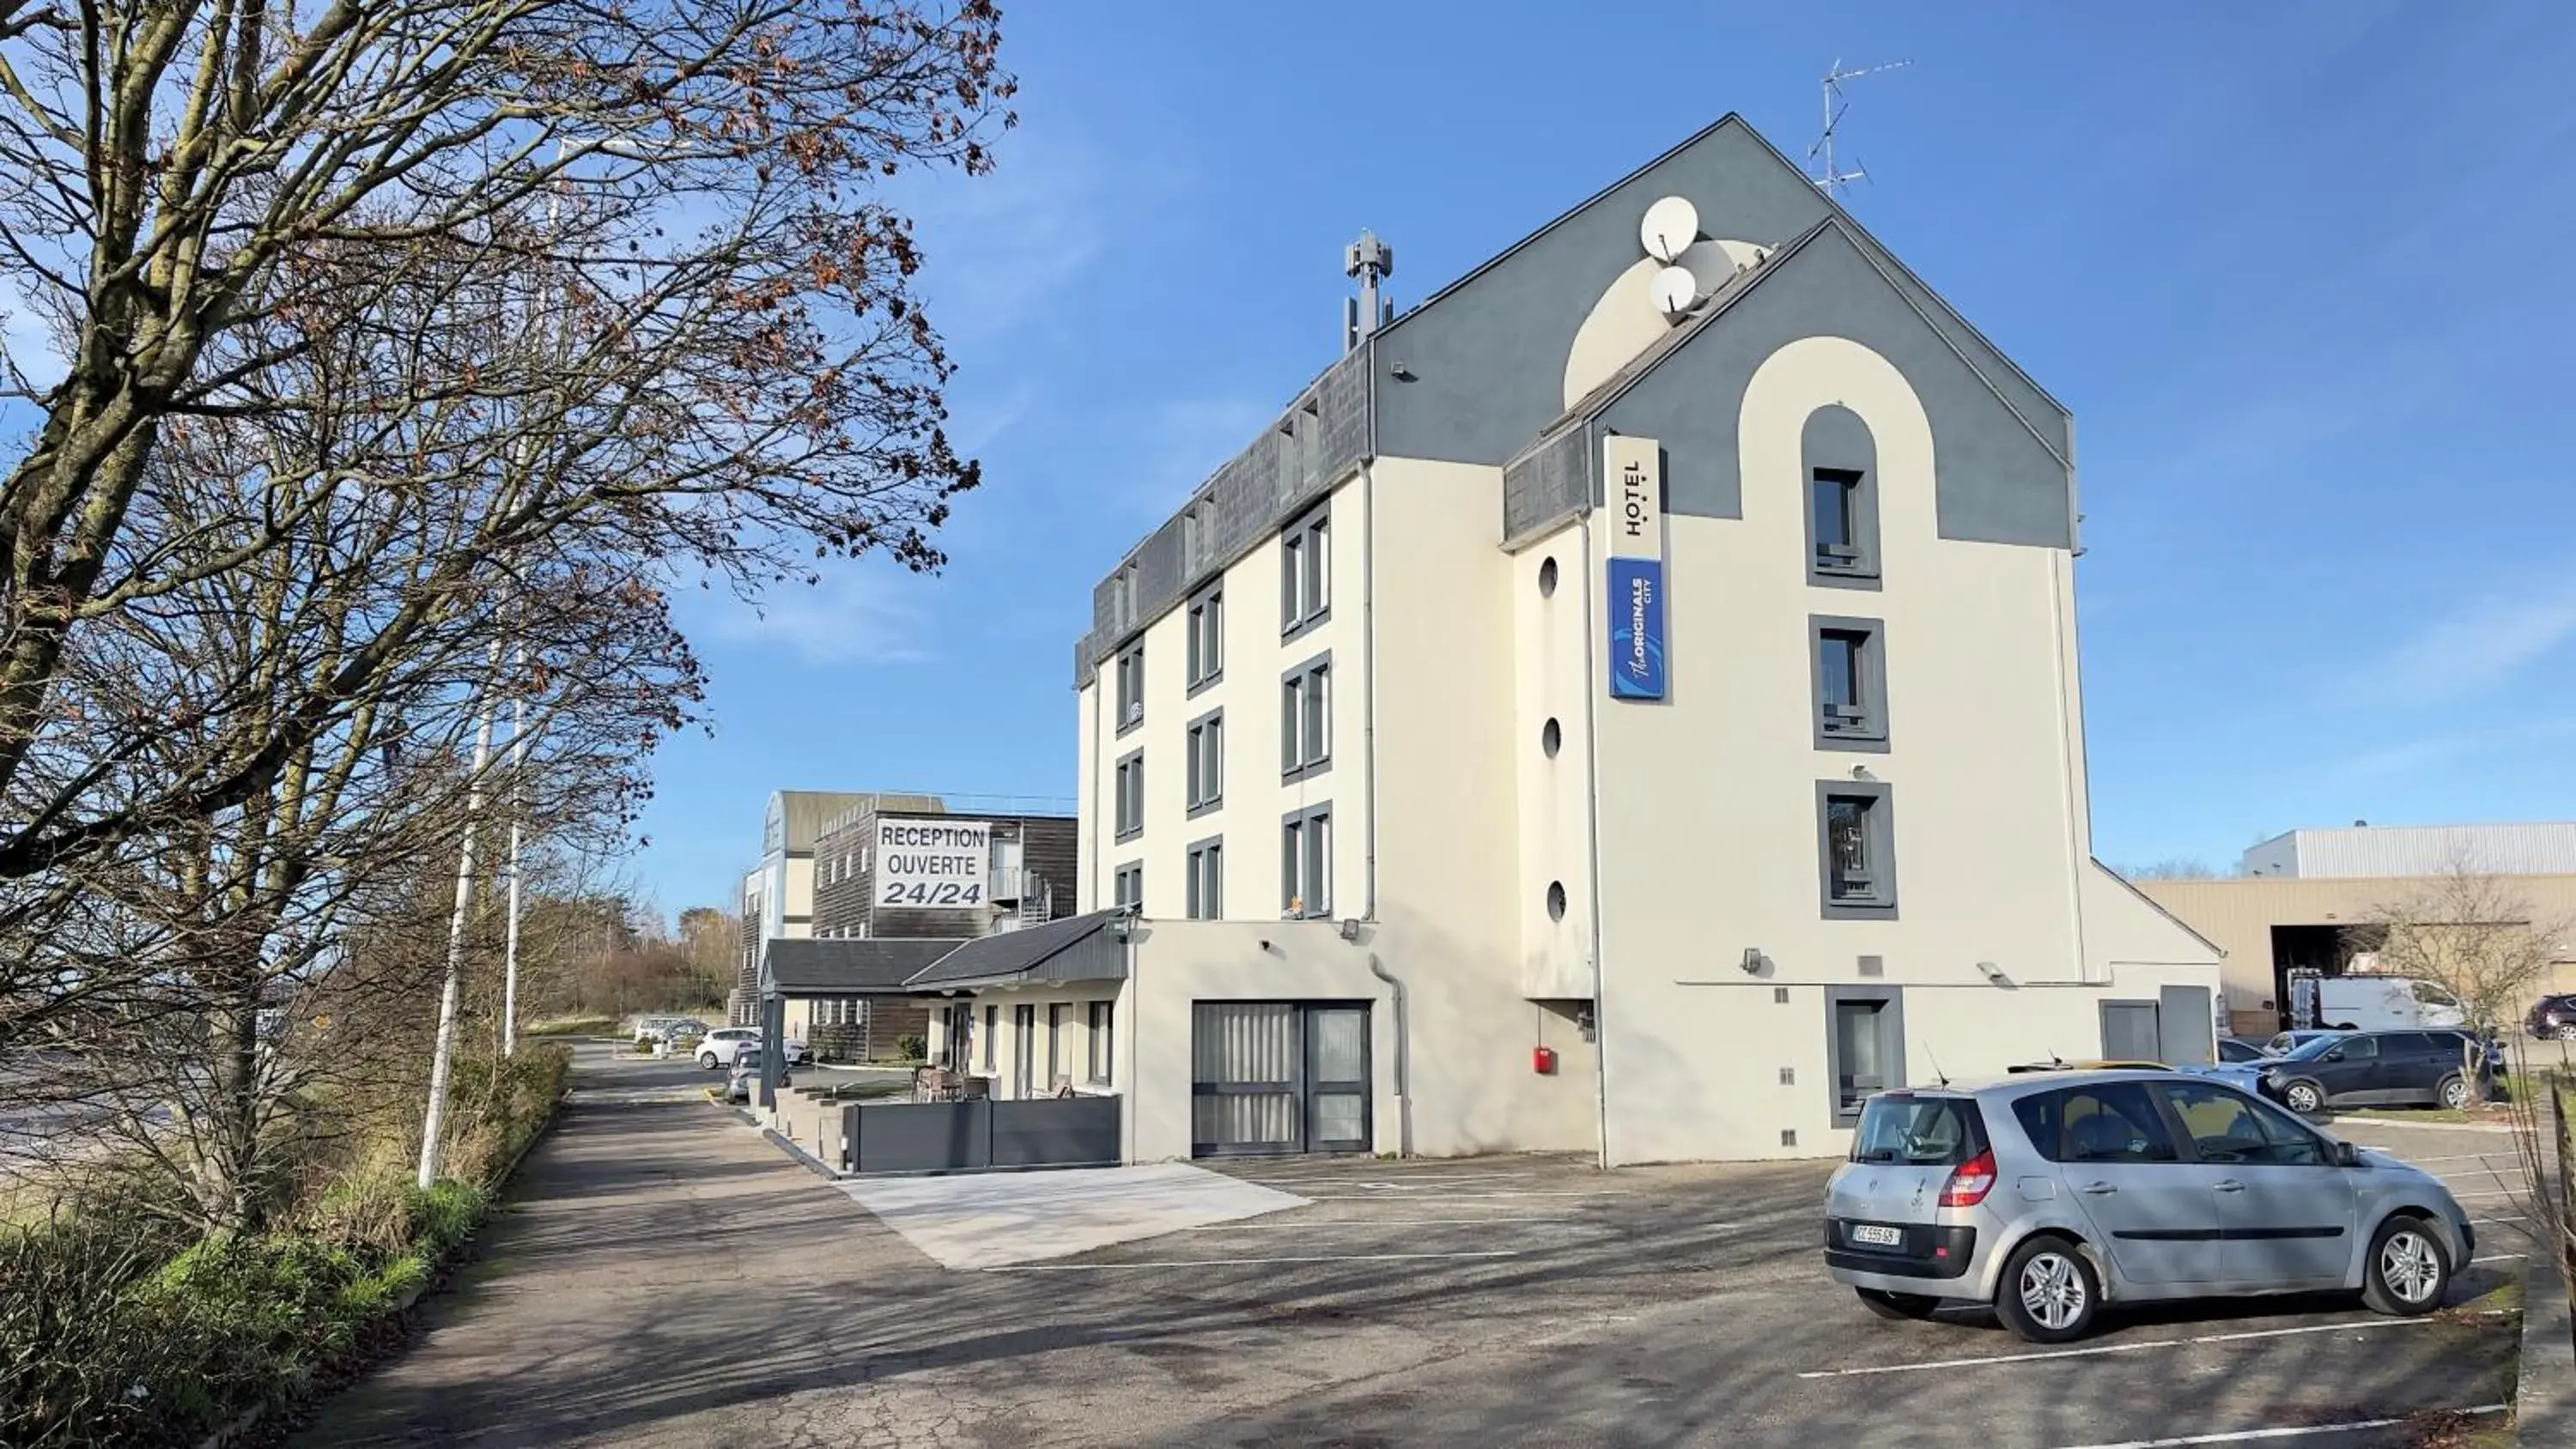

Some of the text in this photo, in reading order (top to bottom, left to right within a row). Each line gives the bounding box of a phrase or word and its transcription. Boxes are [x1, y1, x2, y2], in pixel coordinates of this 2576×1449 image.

[1625, 461, 1641, 537] HOTEL
[1643, 579, 1652, 604] CITY
[1632, 578, 1645, 657] ORIGINALS
[881, 827, 985, 848] RECEPTION
[888, 854, 976, 876] OUVERTE
[883, 882, 981, 905] 24/24
